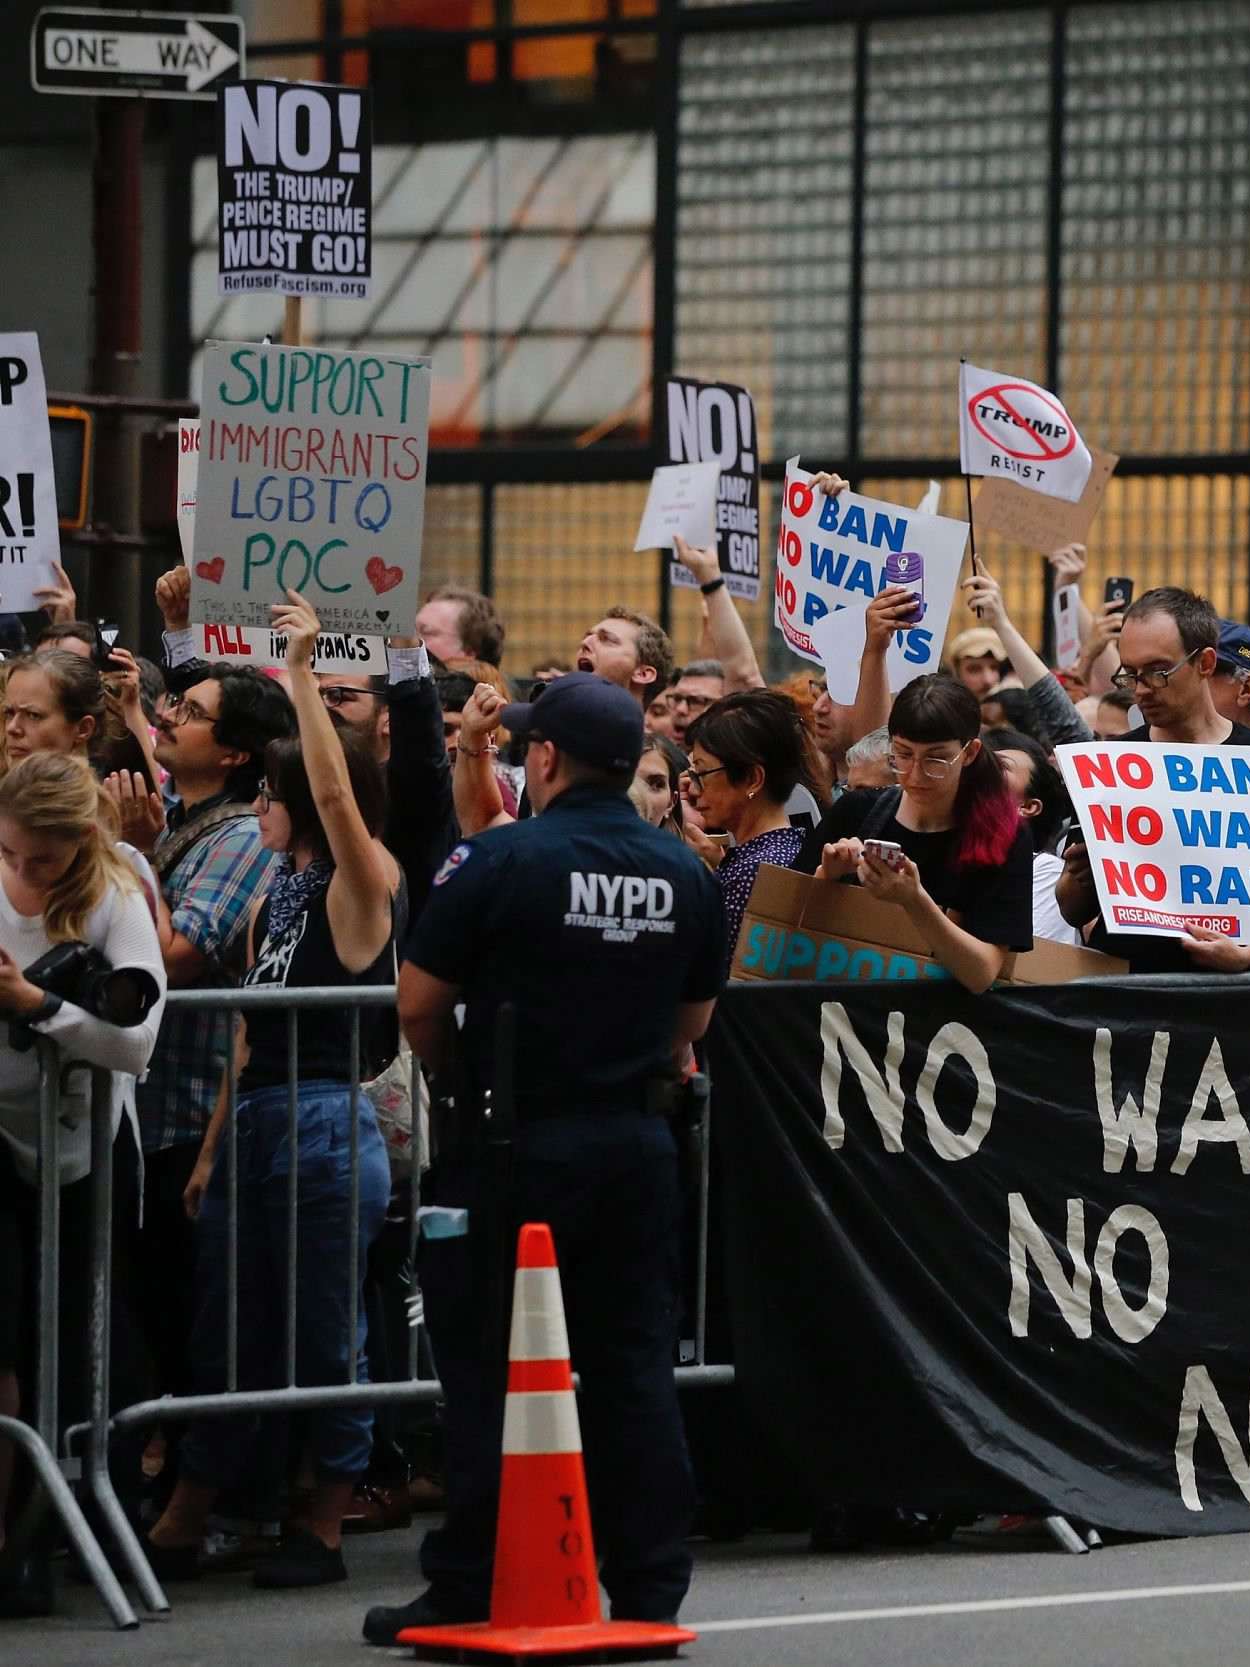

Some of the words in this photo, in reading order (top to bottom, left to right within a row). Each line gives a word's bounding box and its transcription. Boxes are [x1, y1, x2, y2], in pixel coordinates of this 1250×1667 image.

[52, 36, 119, 66] ONE
[157, 41, 217, 70] WAY
[224, 85, 361, 173] NO!
[233, 172, 270, 198] THE
[276, 174, 354, 206] TRUMP/
[223, 202, 282, 228] PENCE
[286, 204, 366, 233] REGIME
[224, 231, 303, 270] MUST
[311, 236, 366, 273] GO!
[224, 274, 366, 297] RefuseFascism.org
[219, 350, 424, 424] SUPPORT
[667, 381, 755, 475] NO!
[978, 404, 1067, 439] TRUMP
[209, 419, 420, 481] IMMIGRANTS
[991, 456, 1045, 482] RESIST
[231, 475, 392, 534] LGBTQ
[818, 496, 908, 552] BAN
[242, 532, 352, 593] POC
[728, 532, 758, 577] GO!
[204, 624, 252, 655] ALL
[240, 615, 263, 625] THE
[1072, 753, 1154, 790] NO
[1088, 804, 1164, 845] NO
[570, 872, 674, 919] NYPD
[1101, 858, 1168, 902] NO
[564, 912, 620, 929] STRATEGIC
[623, 918, 676, 933] RESPONSE
[602, 929, 638, 943] GROUP
[1118, 908, 1231, 932] RISEANDRESISTORG
[820, 1001, 997, 1161] NO
[1007, 1192, 1169, 1344] NO
